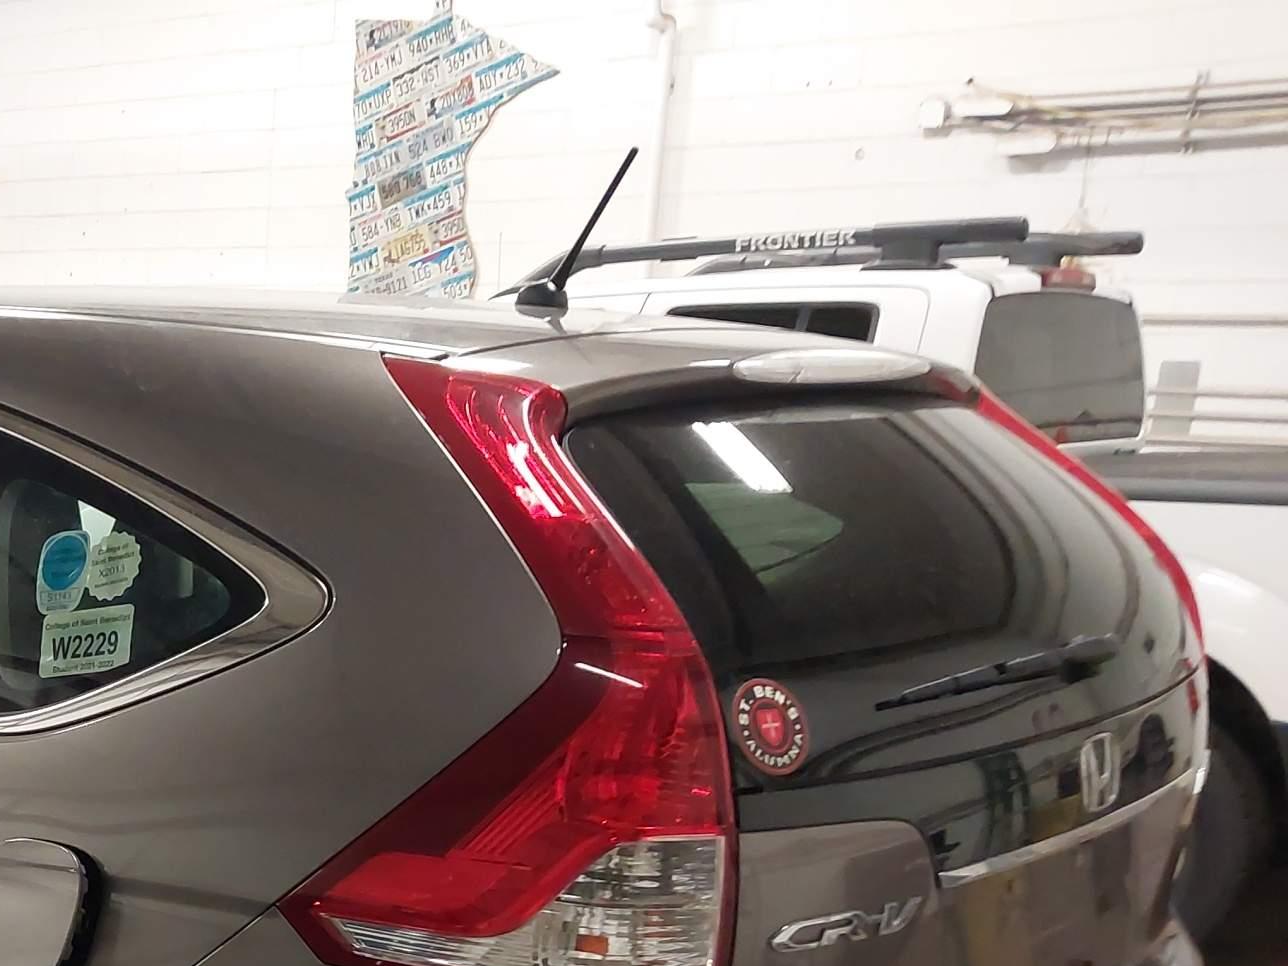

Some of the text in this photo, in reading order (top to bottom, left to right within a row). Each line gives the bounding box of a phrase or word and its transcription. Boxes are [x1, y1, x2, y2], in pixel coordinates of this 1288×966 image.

[734, 229, 857, 252] FRONTIER
[52, 630, 119, 661] W2229
[745, 733, 804, 768] ALUMNA
[772, 896, 923, 952] CR-V
